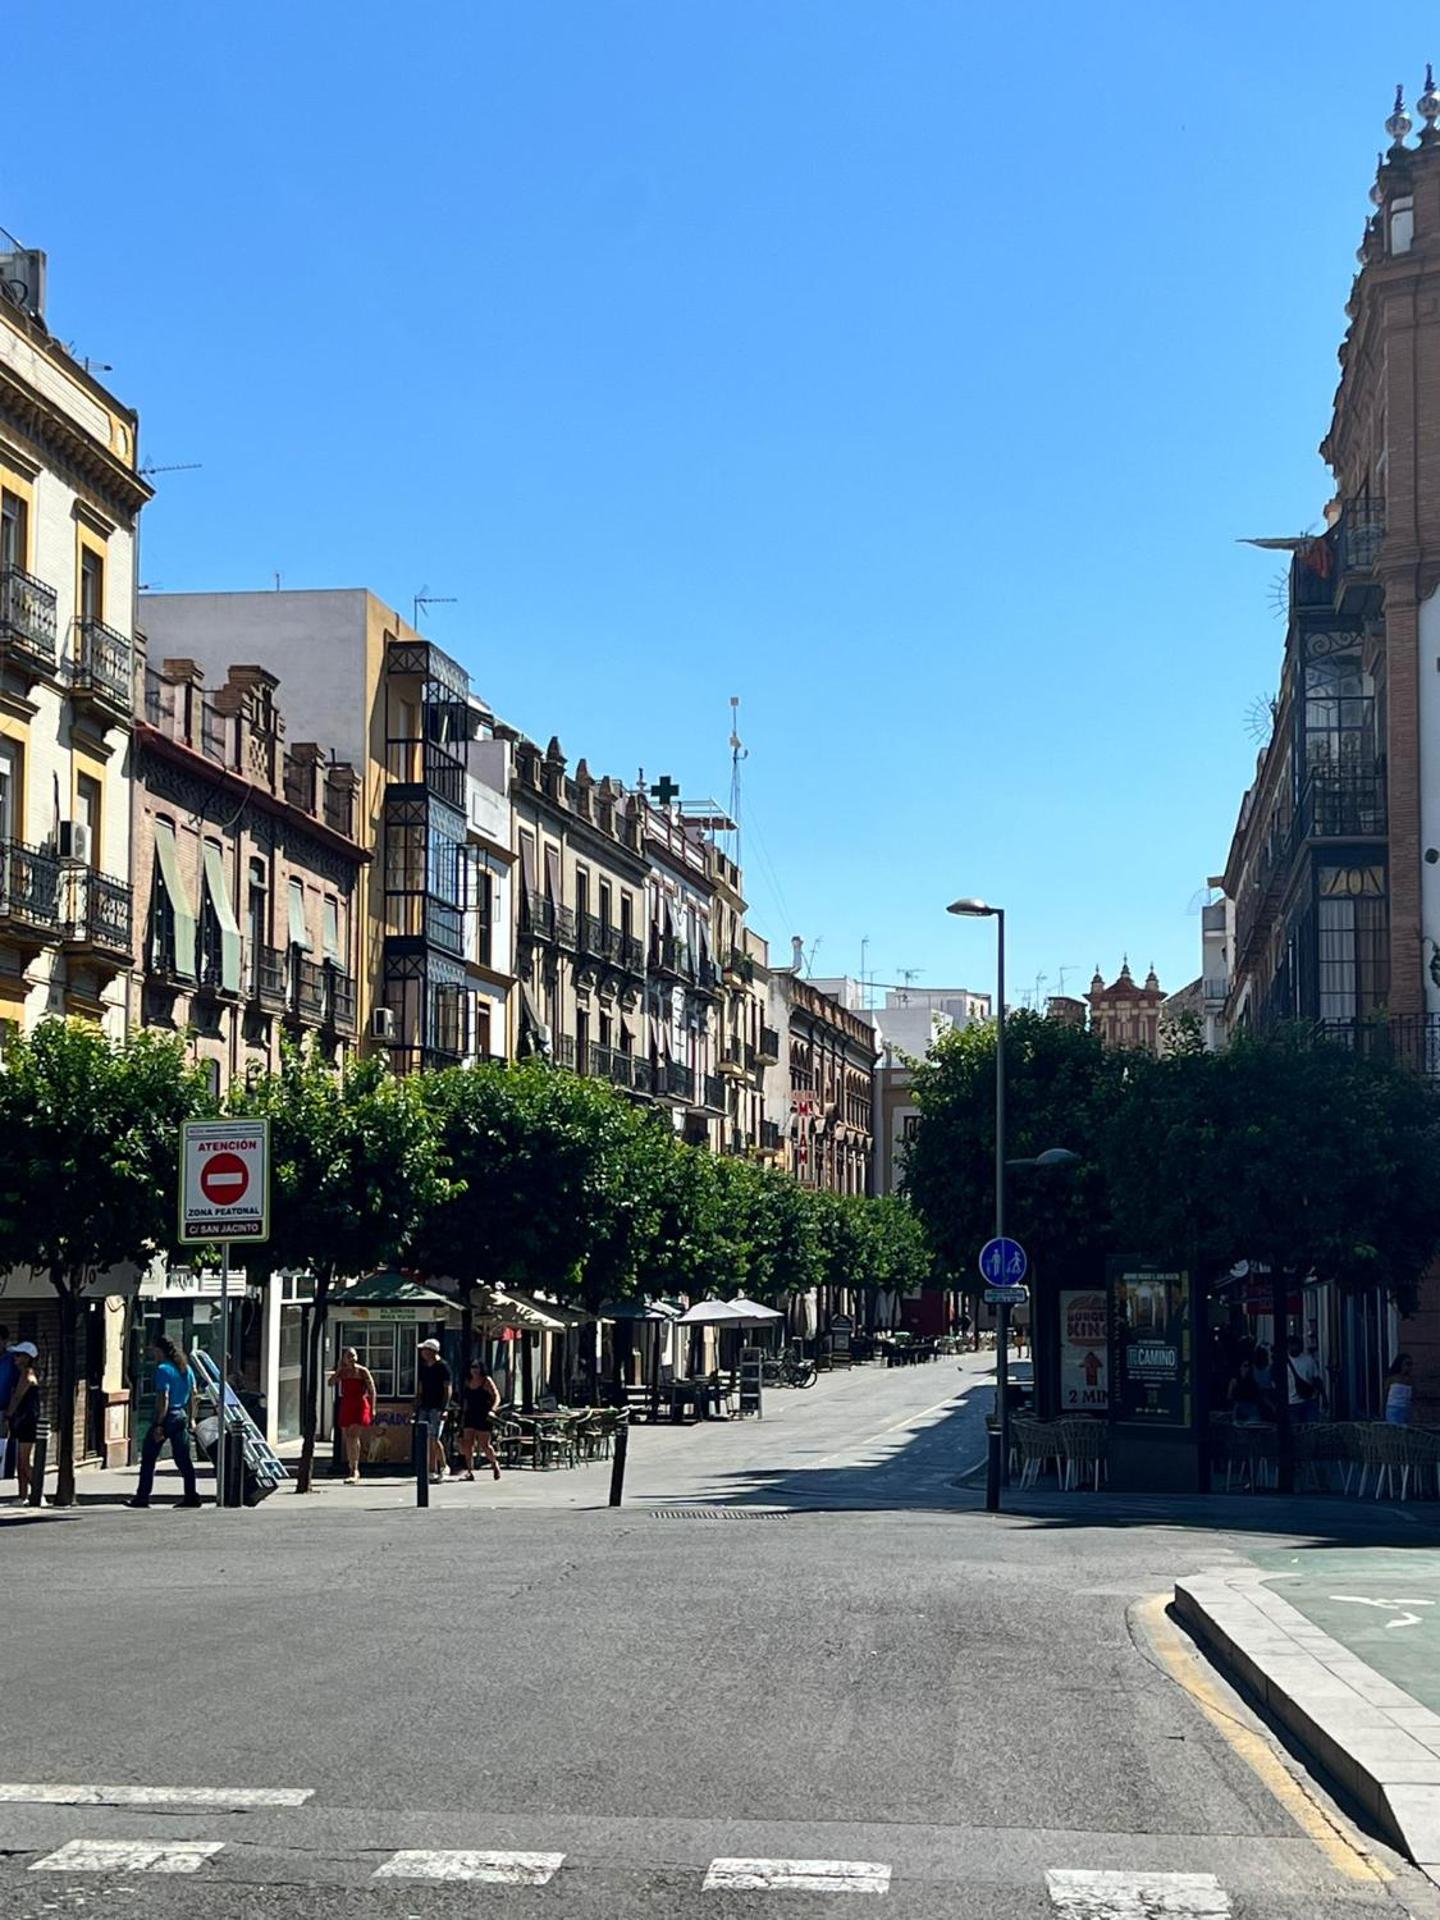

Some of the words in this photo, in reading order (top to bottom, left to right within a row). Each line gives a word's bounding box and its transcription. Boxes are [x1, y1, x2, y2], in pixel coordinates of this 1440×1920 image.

[198, 1140, 257, 1152] ATENCIÓN
[799, 1101, 808, 1180] MIAMI
[188, 1208, 213, 1217] ZONA
[215, 1207, 260, 1216] PEATONAL
[189, 1225, 200, 1234] C/
[200, 1225, 219, 1234] SAN
[220, 1223, 259, 1233] JACINTO
[1067, 1311, 1107, 1322] BURGE
[1138, 1348, 1175, 1367] CAMINO
[1068, 1389, 1078, 1404] 2
